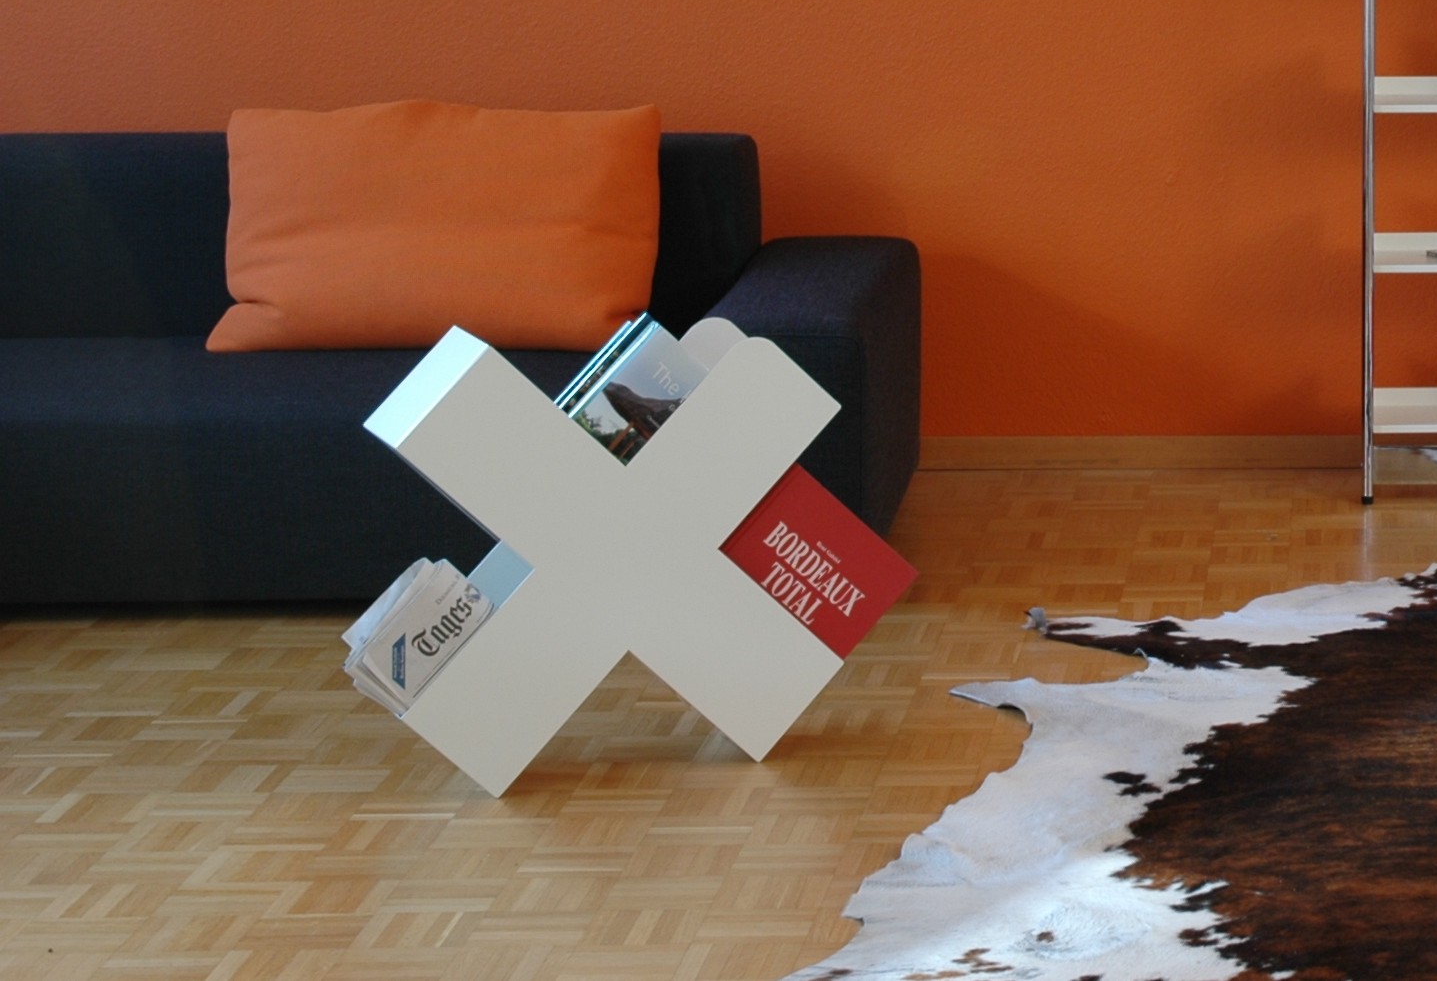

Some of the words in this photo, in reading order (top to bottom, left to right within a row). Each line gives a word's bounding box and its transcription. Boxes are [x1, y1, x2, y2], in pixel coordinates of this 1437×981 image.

[651, 361, 680, 396] The
[760, 561, 823, 626] TOTAL
[762, 520, 866, 618] BORDEAUX
[411, 596, 474, 658] Tages
